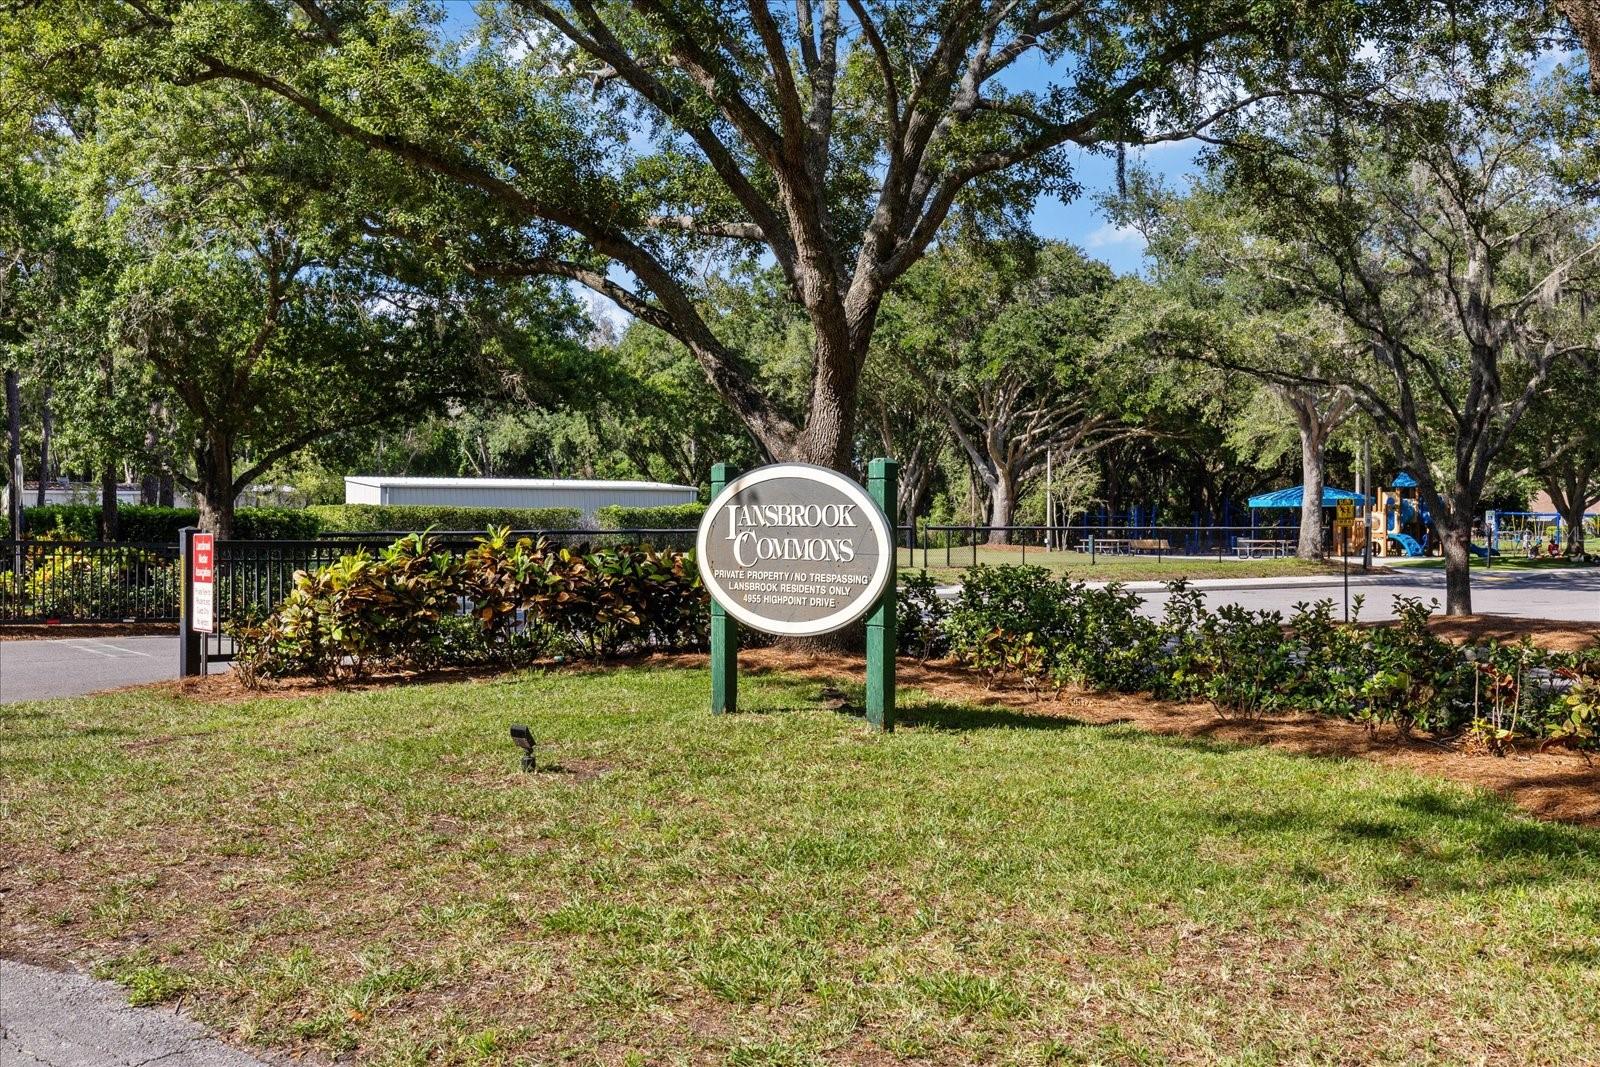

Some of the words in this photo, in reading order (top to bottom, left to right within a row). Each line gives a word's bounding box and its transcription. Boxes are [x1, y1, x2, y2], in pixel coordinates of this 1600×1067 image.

[725, 504, 858, 540] LANSBROOK
[733, 530, 855, 568] COMMONS
[714, 569, 744, 580] PRIVATE
[747, 570, 807, 582] PROPERTY/NO
[810, 573, 868, 585] TRESPASSING
[728, 582, 778, 592] LANSBROOK
[780, 584, 826, 594] RESIDENTS
[829, 586, 851, 597] ONLY
[743, 594, 761, 603] 4955
[763, 595, 807, 606] HIGHPOINT
[810, 597, 836, 608] DRIVE
